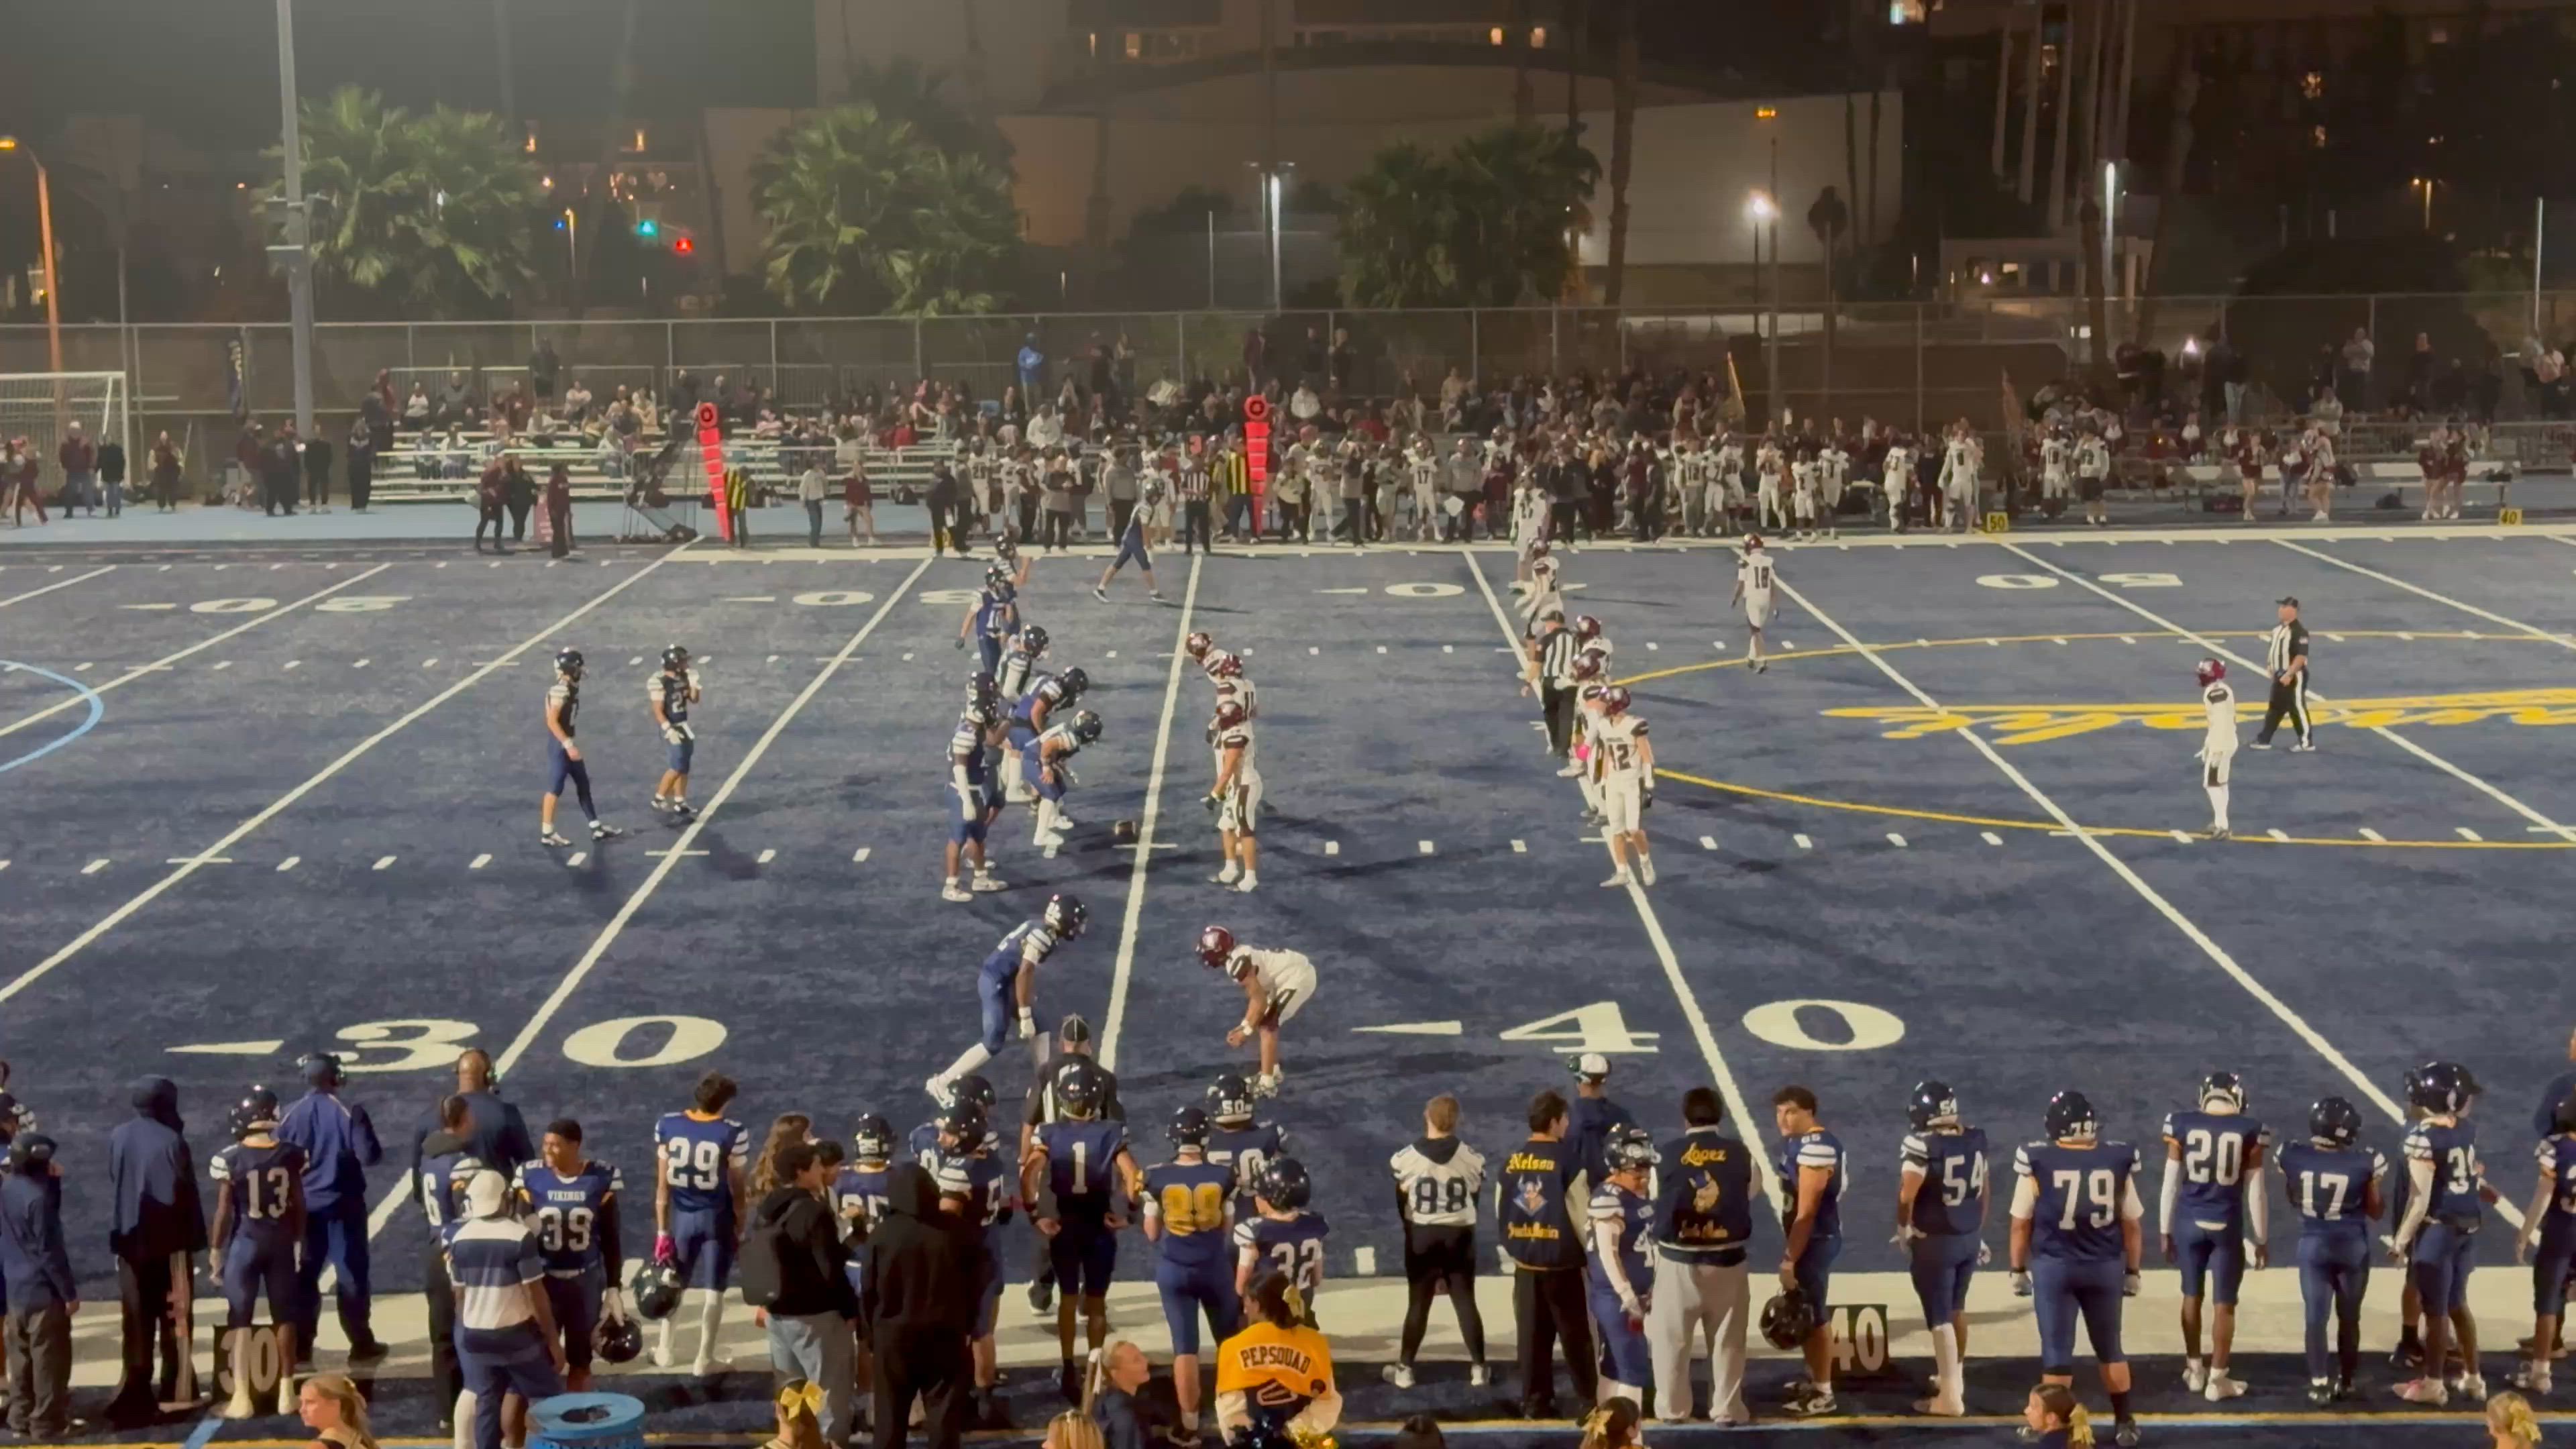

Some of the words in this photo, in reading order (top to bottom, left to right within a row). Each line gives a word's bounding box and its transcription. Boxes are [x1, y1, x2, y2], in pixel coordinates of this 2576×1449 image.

[1990, 517, 2006, 531] 50
[2501, 509, 2518, 525] 40
[1609, 743, 1631, 771] 12
[1221, 1099, 1244, 1115] 50
[666, 1136, 720, 1191] 29
[1072, 1141, 1088, 1193] 1
[1505, 1152, 1556, 1174] Nelson
[1942, 1150, 1984, 1206] 54
[2186, 1129, 2244, 1186] 20
[247, 1167, 290, 1219] 13
[547, 1189, 587, 1202] VIKINGS
[1414, 1175, 1468, 1215] 88
[2053, 1169, 2115, 1230] 79
[2300, 1171, 2350, 1221] 17
[538, 1205, 594, 1252] 39
[1270, 1238, 1323, 1290] 32
[1829, 1306, 1885, 1372] 40
